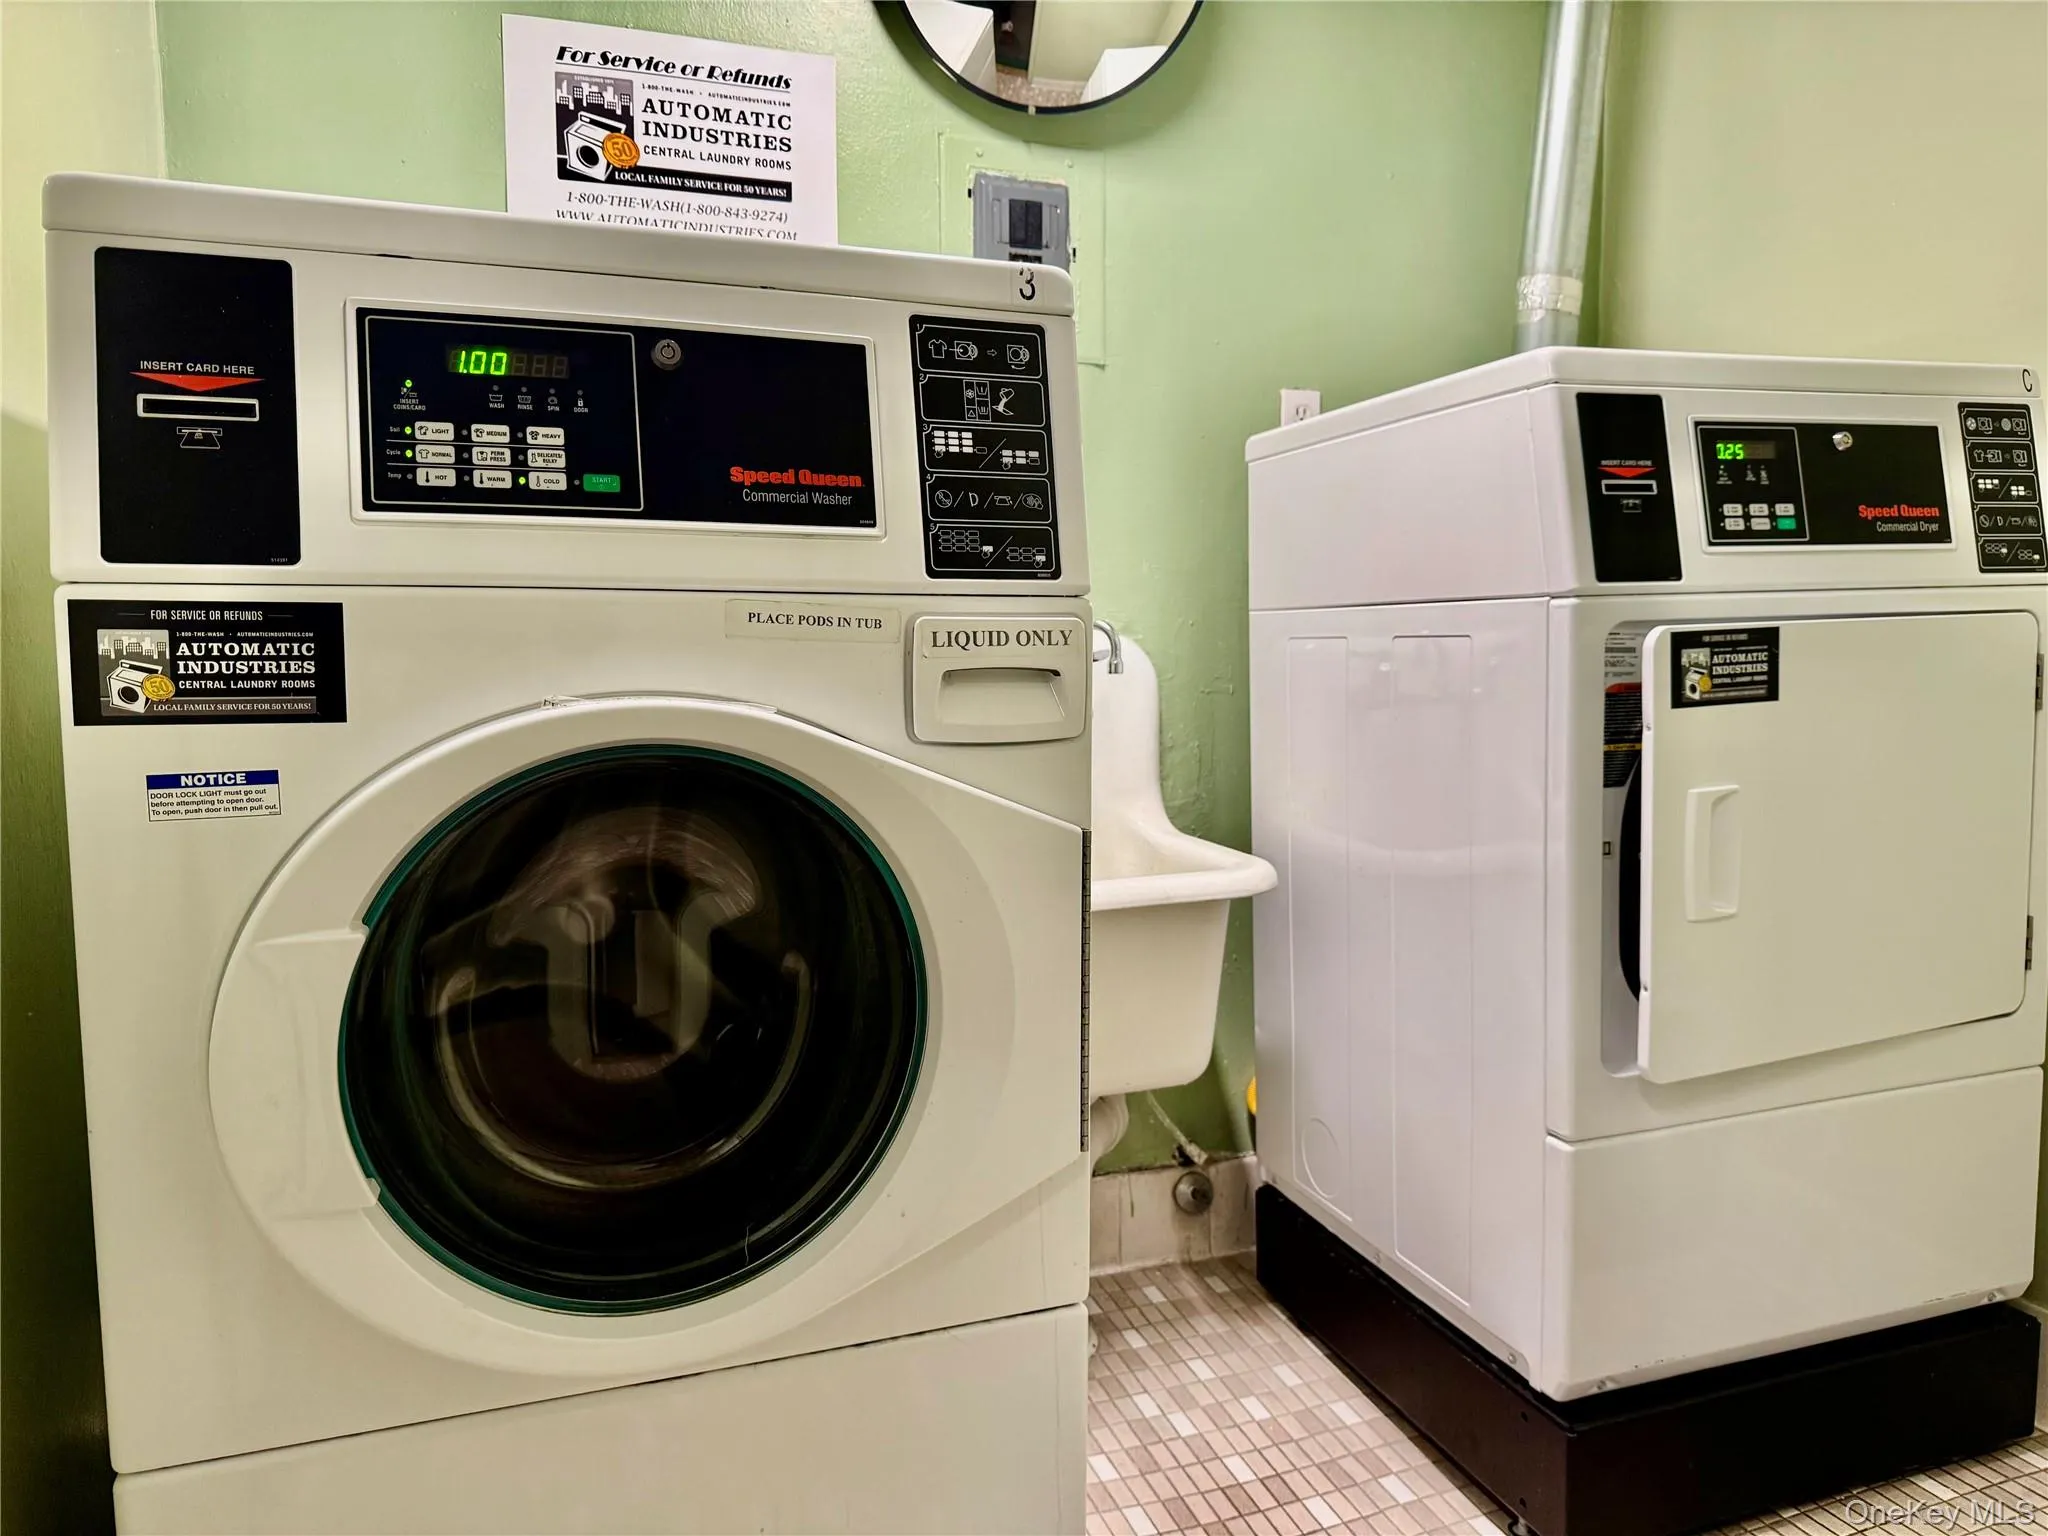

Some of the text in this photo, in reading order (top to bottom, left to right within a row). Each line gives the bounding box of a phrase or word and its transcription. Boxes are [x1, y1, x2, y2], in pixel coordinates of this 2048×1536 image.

[556, 45, 792, 90] For Service or Refunds
[641, 97, 792, 131] AUTOMATIC
[642, 119, 792, 152] INDUSTRIES
[611, 141, 633, 158] 50
[643, 145, 792, 171] CENTRAL LAUNDRY ROOMS
[614, 171, 788, 197] LOCAL FAMILY SERVICE FOR 50 YEARS!
[566, 190, 789, 225] 1-800-THE-WASH(1-800-843-9274)
[1019, 267, 1035, 301] 3
[140, 360, 255, 375] INSERT CARD HERE
[459, 350, 507, 376] 1.00
[919, 373, 925, 381] 2
[2022, 368, 2033, 392] C
[393, 403, 426, 411] COINS/CARD
[922, 423, 928, 431] 3
[386, 448, 401, 456] Cycle
[591, 476, 612, 484] START
[729, 466, 863, 488] Speed Queen
[742, 488, 853, 506] Commercial Washer
[1858, 504, 1940, 520] Speed Queen
[1876, 521, 1940, 533] Commercial Dryer
[150, 609, 263, 622] FOR SERVICE OR REFUNDS
[747, 611, 882, 630] PLACE PODS IN TUB
[931, 629, 1073, 652] LIQUID ONLY
[176, 643, 315, 656] AUTOMATIC
[1711, 652, 1769, 664] AUTOMATIC
[176, 660, 316, 675] INDUSTRIES
[1711, 663, 1769, 675] INDUSTRIES
[150, 680, 169, 693] 50
[178, 680, 316, 689] CENTRAL LAUNDRY ROOMS
[217, 703, 254, 711] SERVICE
[180, 773, 247, 787] NOTICE
[150, 792, 174, 800] DOOR
[176, 791, 197, 799] LOCK
[199, 790, 222, 798] LIGHT
[150, 800, 175, 808] before
[176, 799, 215, 808] attempting
[226, 797, 244, 805] open
[162, 809, 183, 817] open,
[184, 807, 203, 815] push
[249, 804, 263, 812] pull
